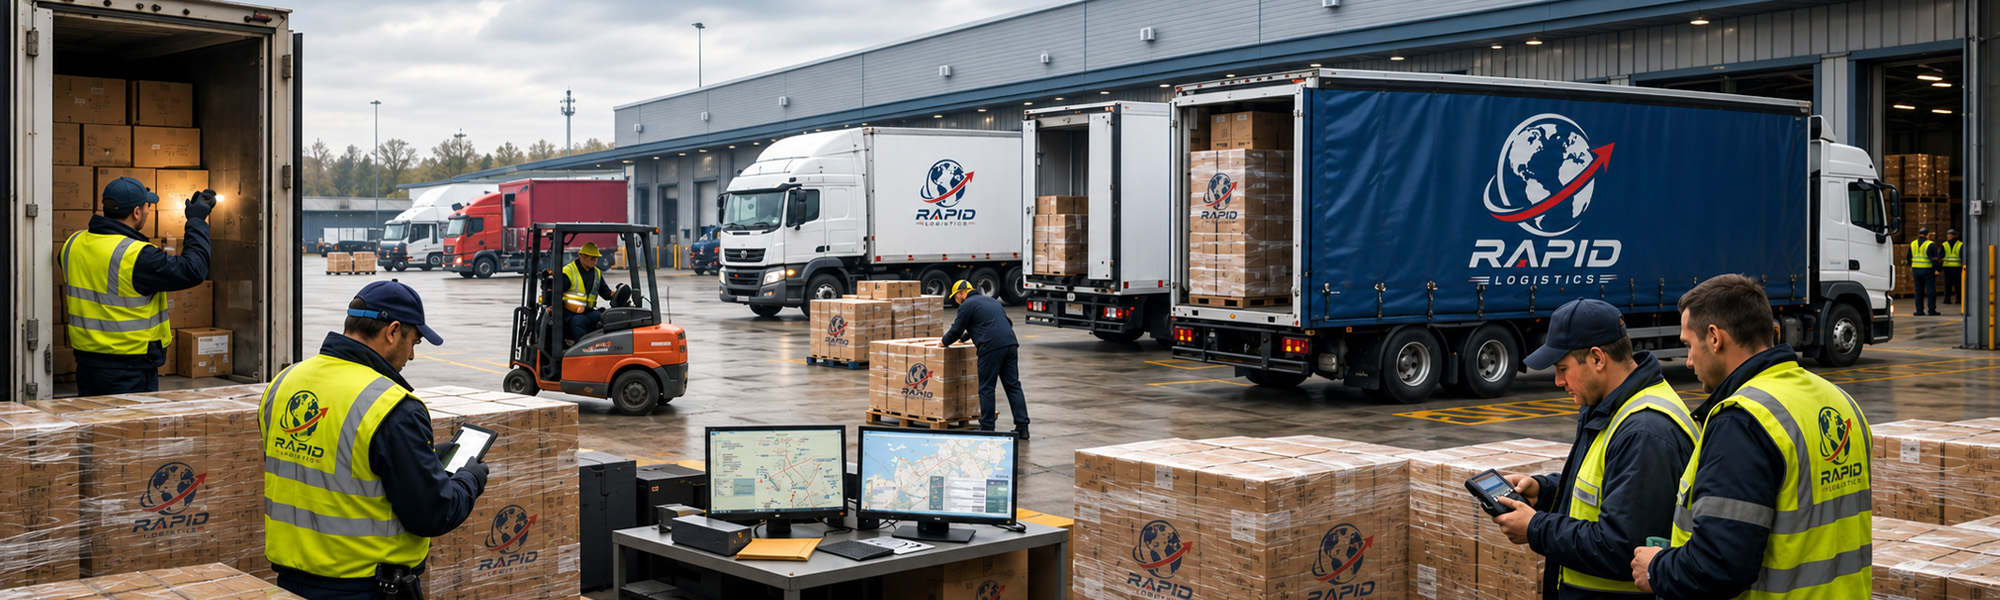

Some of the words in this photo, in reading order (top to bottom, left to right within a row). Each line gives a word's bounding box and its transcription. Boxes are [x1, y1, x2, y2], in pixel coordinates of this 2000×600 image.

[916, 209, 976, 220] RAPID
[1201, 211, 1238, 220] RAPID
[1468, 239, 1622, 268] RAPID
[1494, 275, 1594, 285] LOGISTICS
[275, 436, 325, 458] RAPID
[1820, 462, 1863, 486] RAPID
[132, 512, 210, 533] RAPID
[479, 551, 538, 571] RAPID
[1127, 572, 1194, 600] RAPID
